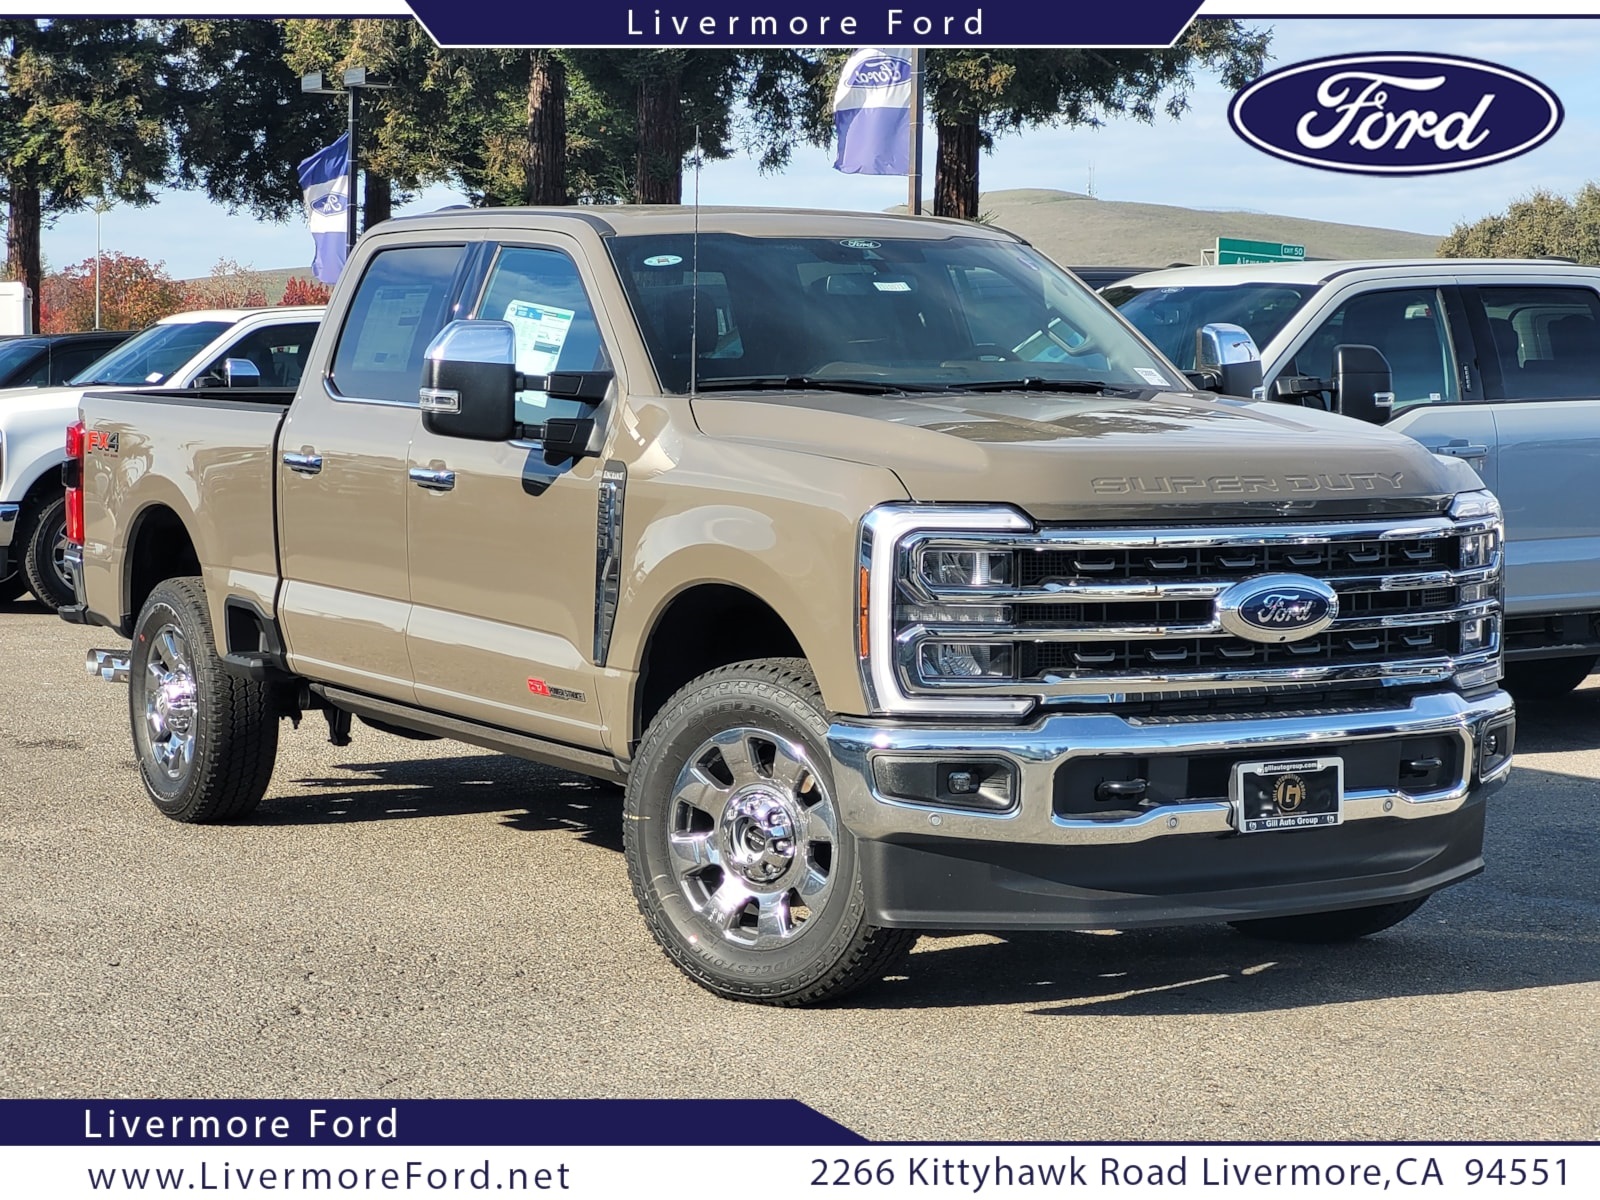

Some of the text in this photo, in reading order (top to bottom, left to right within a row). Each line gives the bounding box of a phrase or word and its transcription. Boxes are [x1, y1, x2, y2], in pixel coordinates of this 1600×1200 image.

[847, 239, 875, 248] Ford
[1294, 247, 1303, 256] 50
[87, 430, 119, 454] FX4
[1090, 472, 1404, 495] SUPER DUTY
[1257, 594, 1313, 623] Ford
[1264, 763, 1317, 772] gillautogroup.com
[1266, 819, 1278, 828] Gill
[1279, 818, 1295, 827] Auto
[1297, 816, 1318, 826] Group
